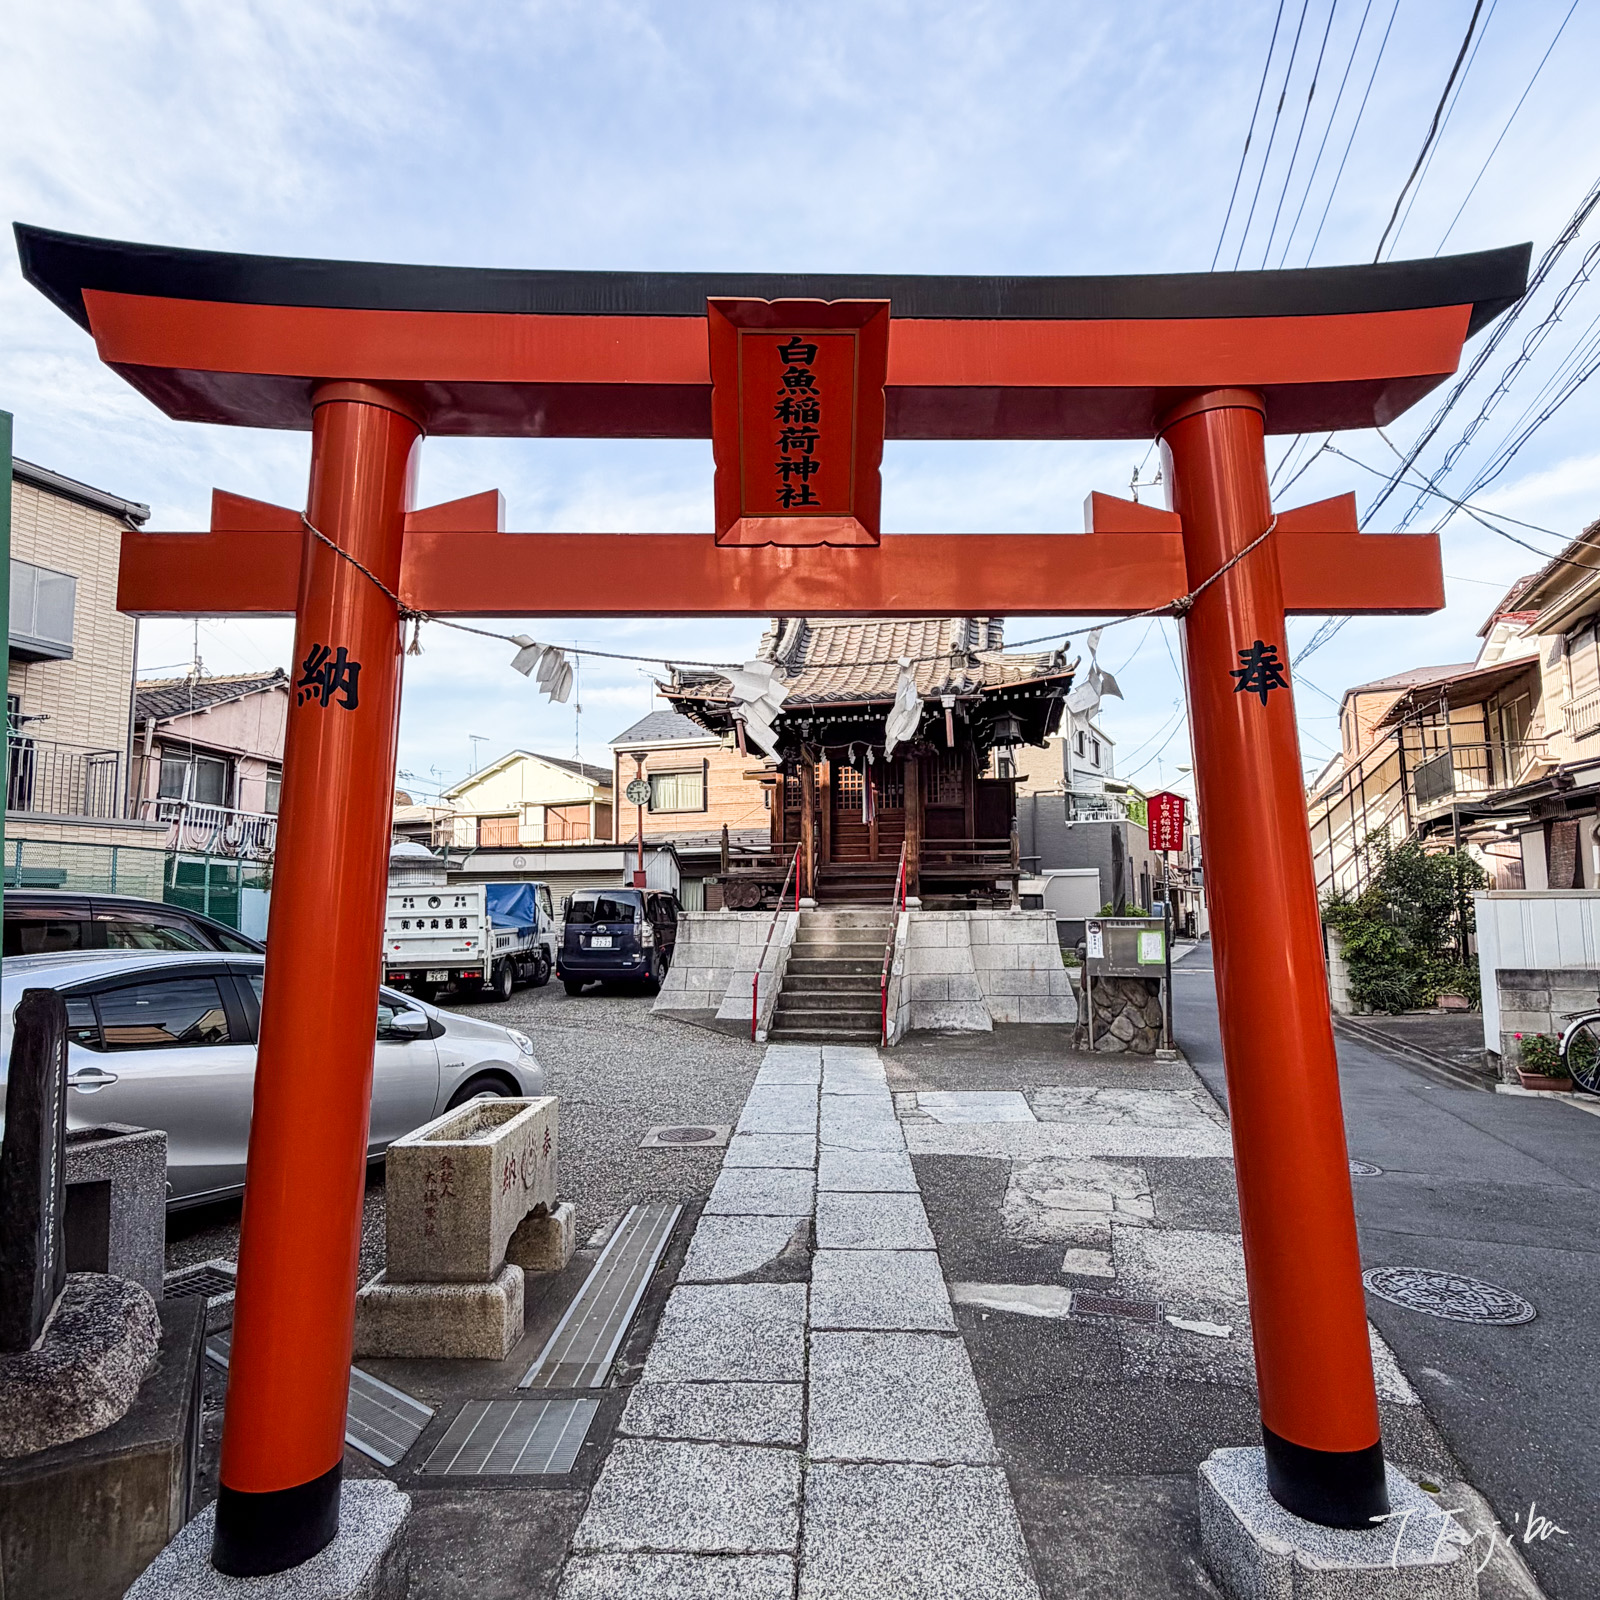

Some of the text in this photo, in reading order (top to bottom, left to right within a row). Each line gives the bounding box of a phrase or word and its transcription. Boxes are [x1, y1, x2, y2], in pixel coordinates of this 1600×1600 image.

[774, 336, 821, 509] 白魚稲荷神社
[297, 643, 362, 711] 納
[1229, 640, 1289, 707] 奉
[1160, 803, 1171, 848] 白魚稲荷神社
